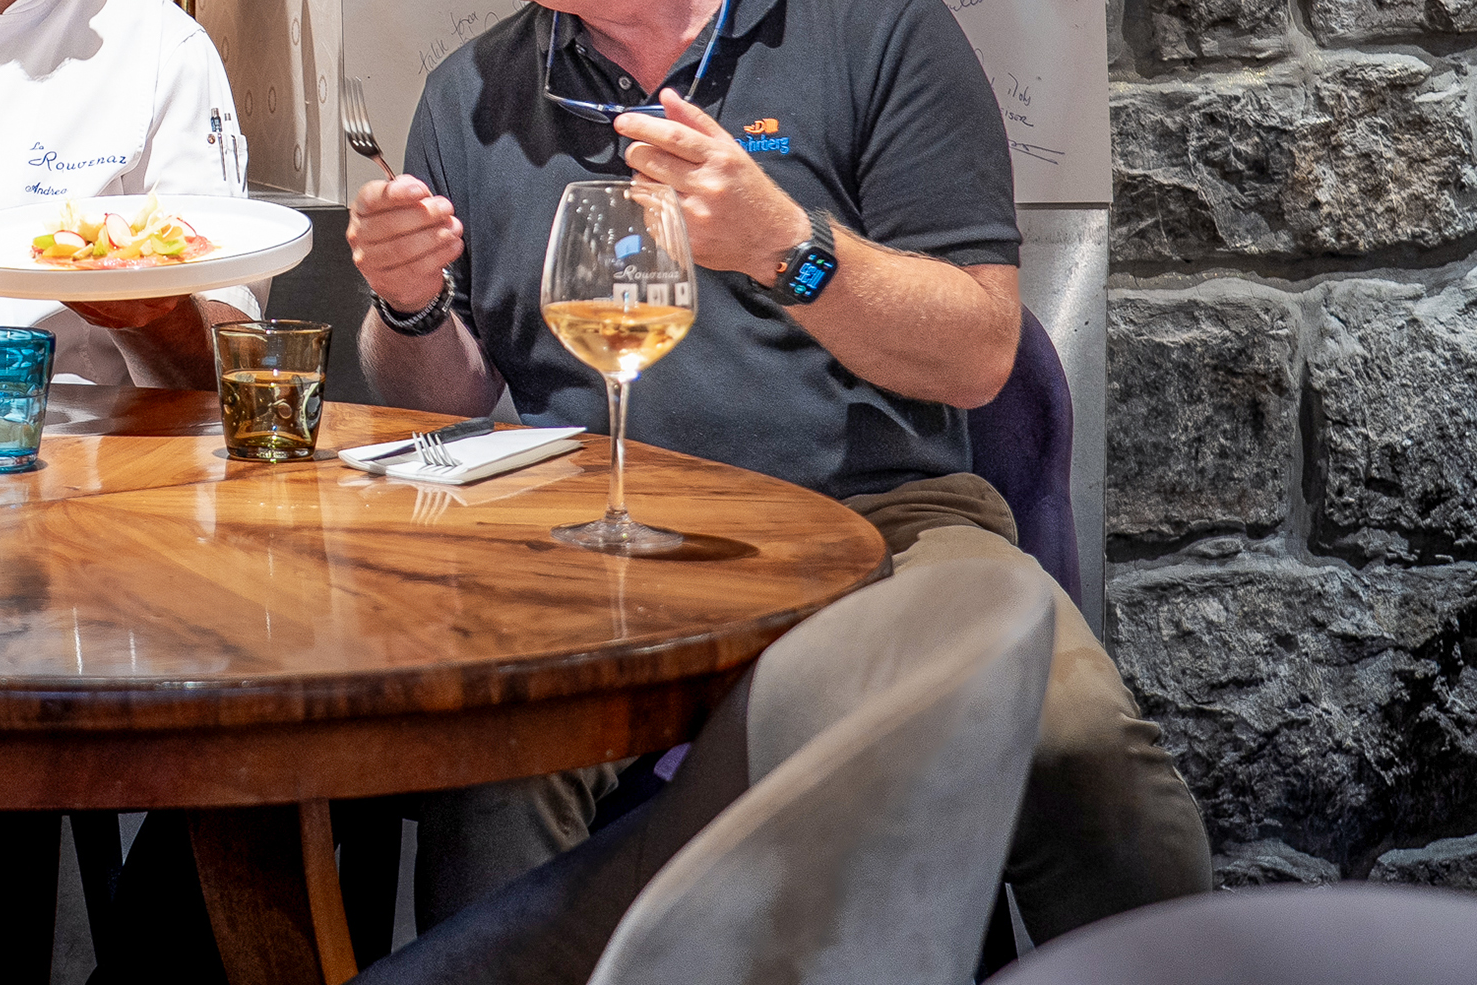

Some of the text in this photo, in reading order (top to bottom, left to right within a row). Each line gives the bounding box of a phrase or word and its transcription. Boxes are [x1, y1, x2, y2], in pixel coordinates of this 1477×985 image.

[29, 142, 44, 151] La
[28, 151, 127, 172] Rouvenaz
[25, 182, 68, 196] Andrea
[613, 264, 680, 282] Rouvenaz
